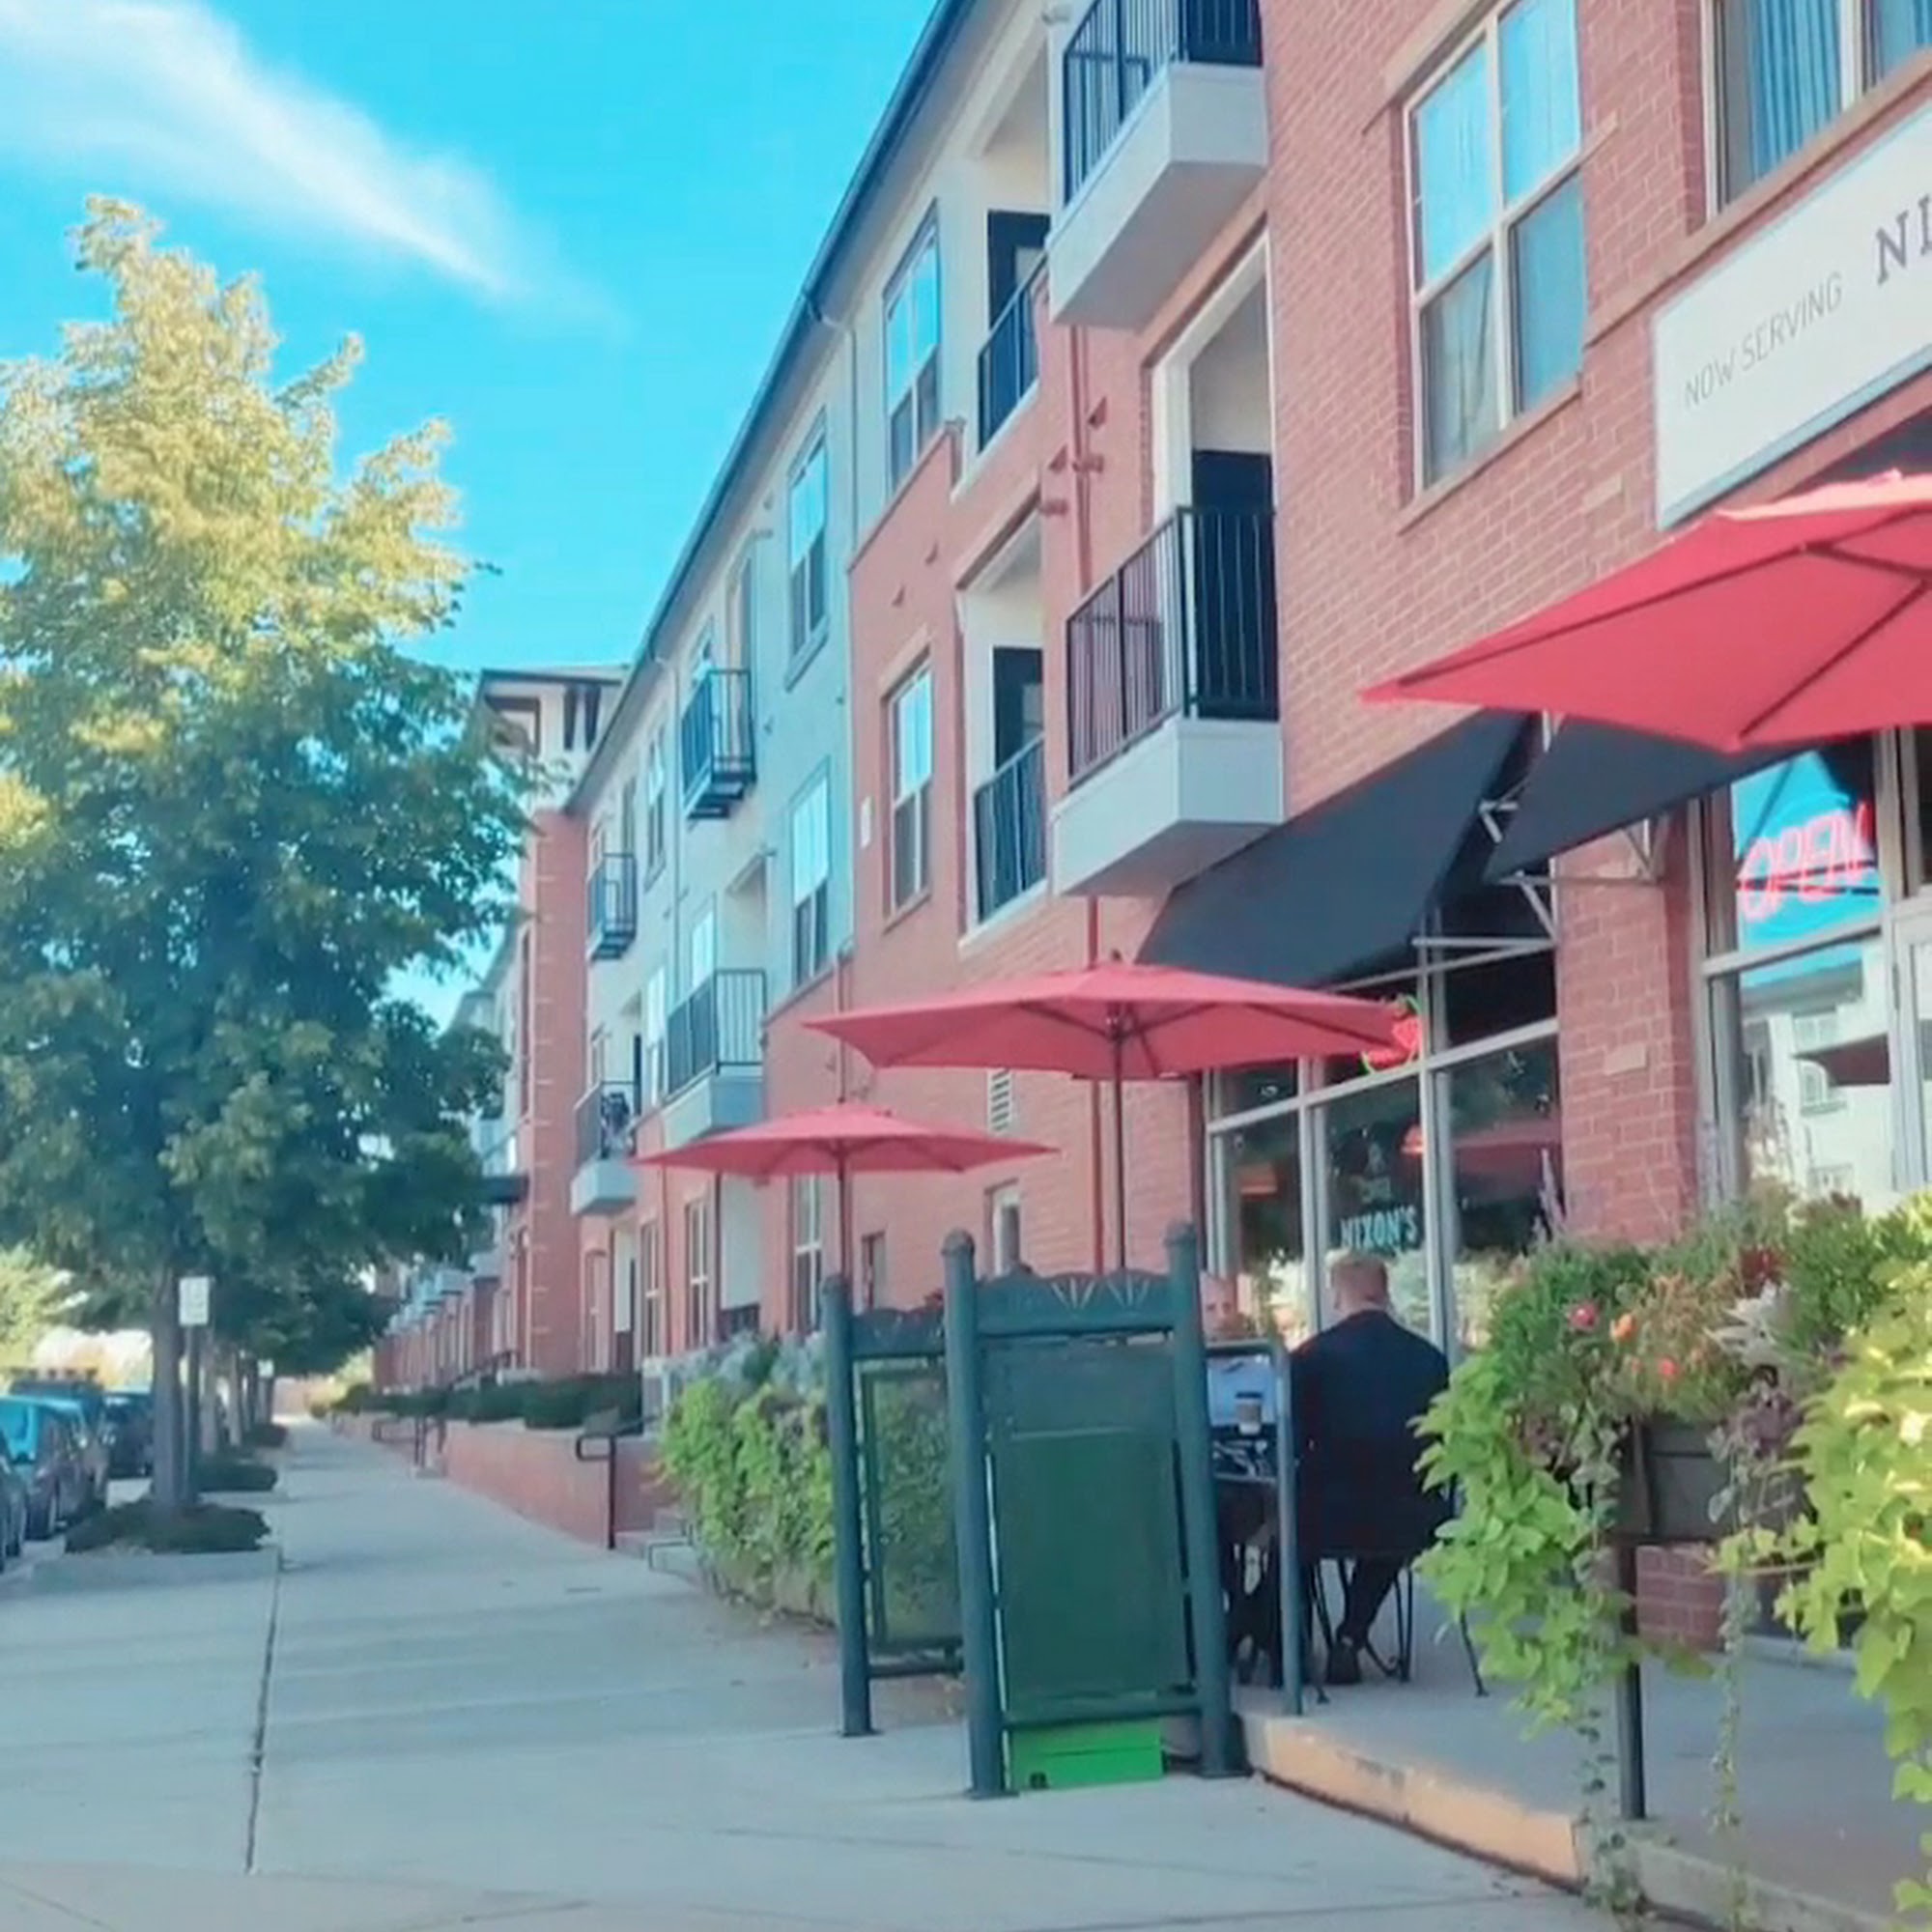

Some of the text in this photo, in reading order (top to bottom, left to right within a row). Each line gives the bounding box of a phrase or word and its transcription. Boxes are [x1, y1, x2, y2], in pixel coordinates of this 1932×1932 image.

[1686, 347, 1736, 410] NOW
[1741, 270, 1843, 372] SERVING
[1736, 800, 1875, 923] OPEN
[1340, 1205, 1418, 1250] NIXON'S
